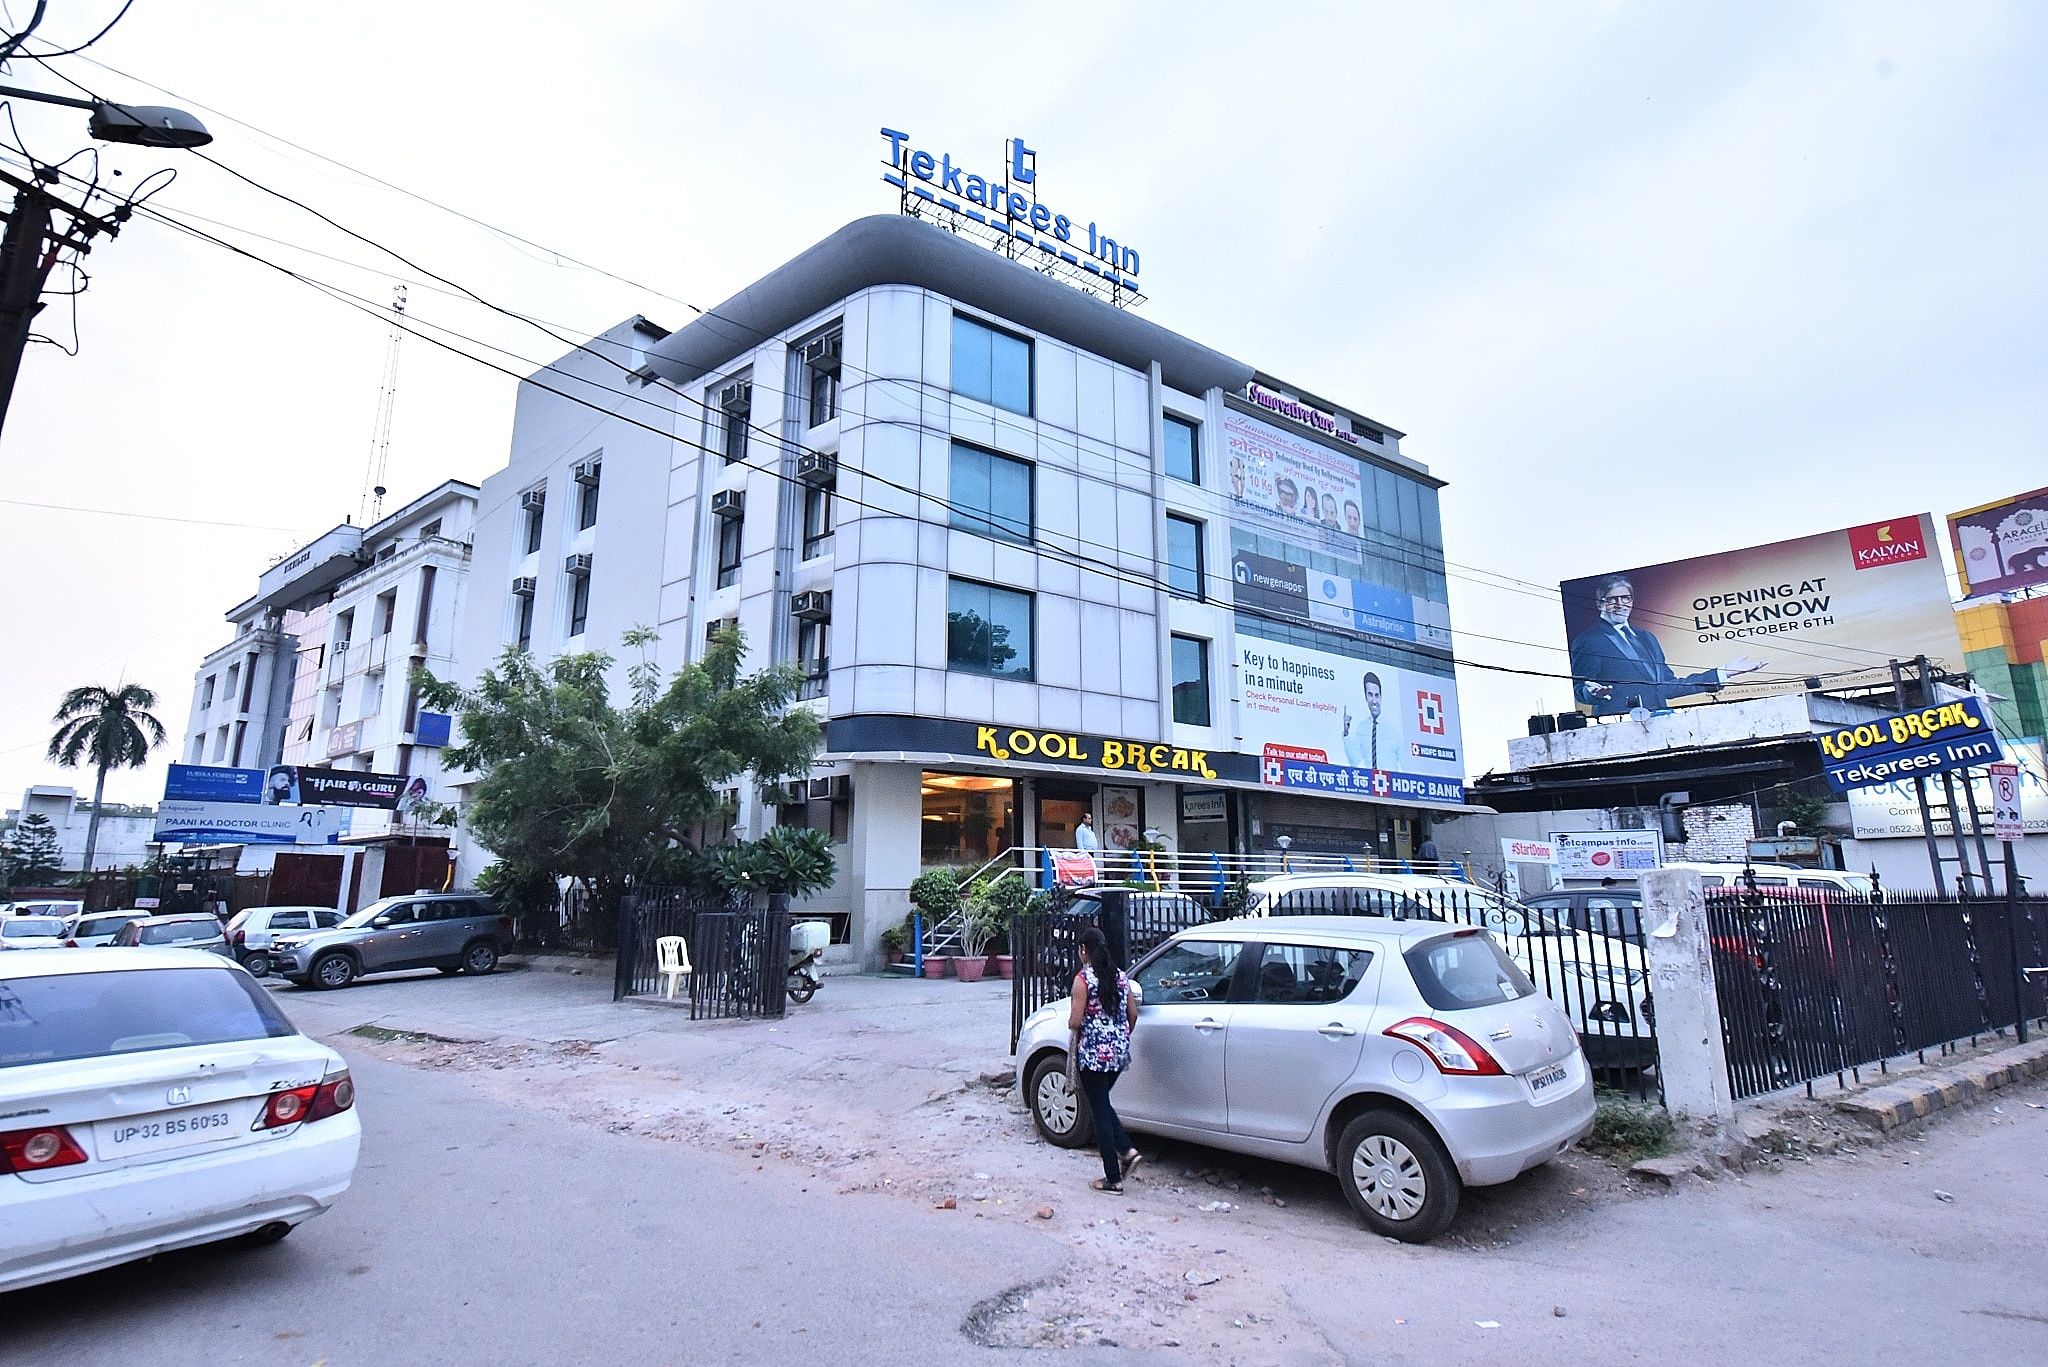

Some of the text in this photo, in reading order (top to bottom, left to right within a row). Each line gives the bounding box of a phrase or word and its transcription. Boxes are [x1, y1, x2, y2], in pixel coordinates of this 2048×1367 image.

[880, 127, 1140, 276] Tekarees Inn
[2002, 518, 2048, 541] ARACEL
[1858, 539, 1919, 562] KALYAN
[1692, 577, 1827, 612] OPENING AT
[1694, 595, 1832, 631] LUCKNOW
[1697, 615, 1835, 644] ON OCTOBER 6TH
[1244, 650, 1336, 681] Key to happiness
[1244, 670, 1304, 695] in a minute
[1246, 690, 1338, 714] Check Personal Loan eligibility
[1246, 701, 1281, 714] in 1 minute
[1820, 702, 1981, 759] KOOL BREAK
[977, 726, 1217, 780] KOOL BREAK
[1265, 746, 1279, 756] Talk
[1278, 749, 1285, 757] to
[1420, 747, 1455, 759] HDFC BANK
[1830, 742, 1992, 784] Tekarees Inn
[313, 777, 347, 792] HAIR
[362, 782, 397, 793] GURU
[1287, 766, 1369, 788] एच डी एफ सी बैंक
[1392, 778, 1426, 795] HDFC
[1428, 782, 1462, 799] BANK
[165, 818, 292, 829] PAANI KA DOCTOR CLINIC
[1856, 825, 1886, 835] Phone:
[114, 1112, 230, 1144] UP 32 BS 6053
